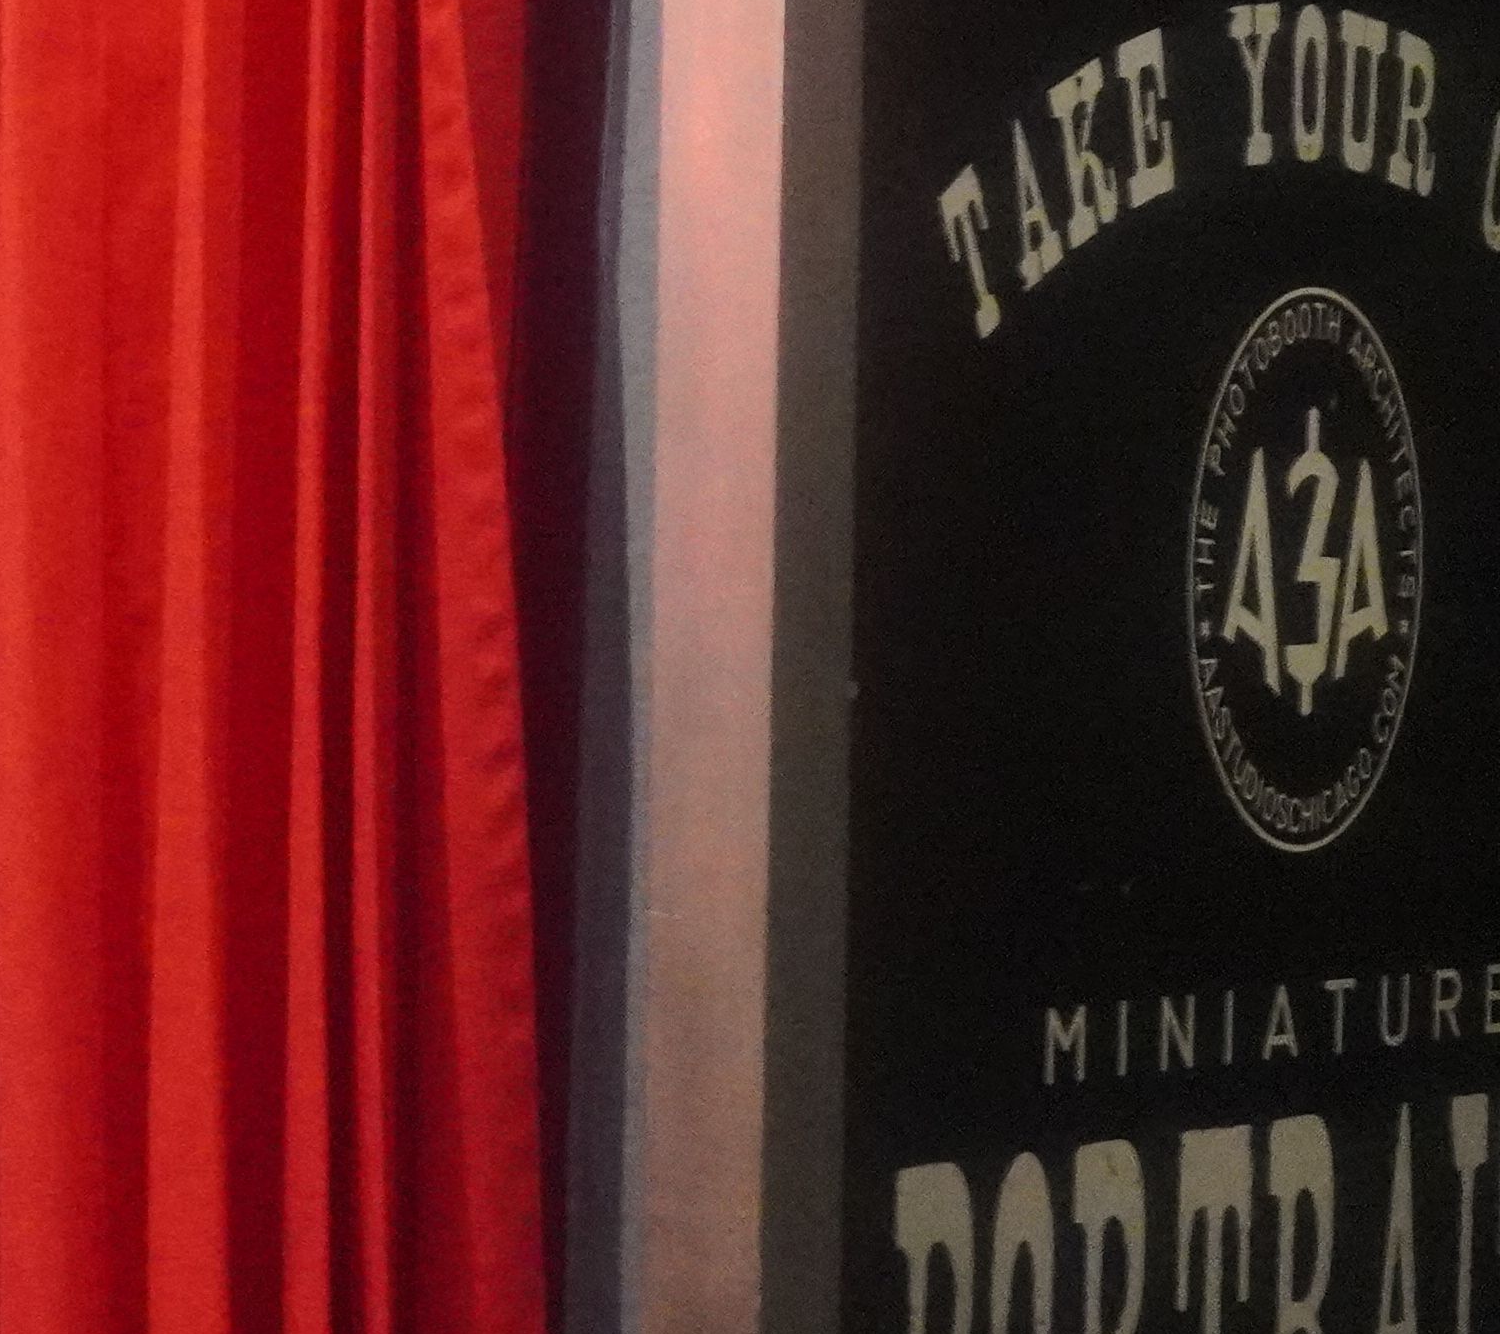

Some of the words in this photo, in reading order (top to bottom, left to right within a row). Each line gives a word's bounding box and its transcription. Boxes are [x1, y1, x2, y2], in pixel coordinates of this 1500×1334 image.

[937, 27, 1178, 339] TAKE
[1227, 1, 1437, 197] YOUR
[1043, 964, 1500, 1085] MINIATURE
